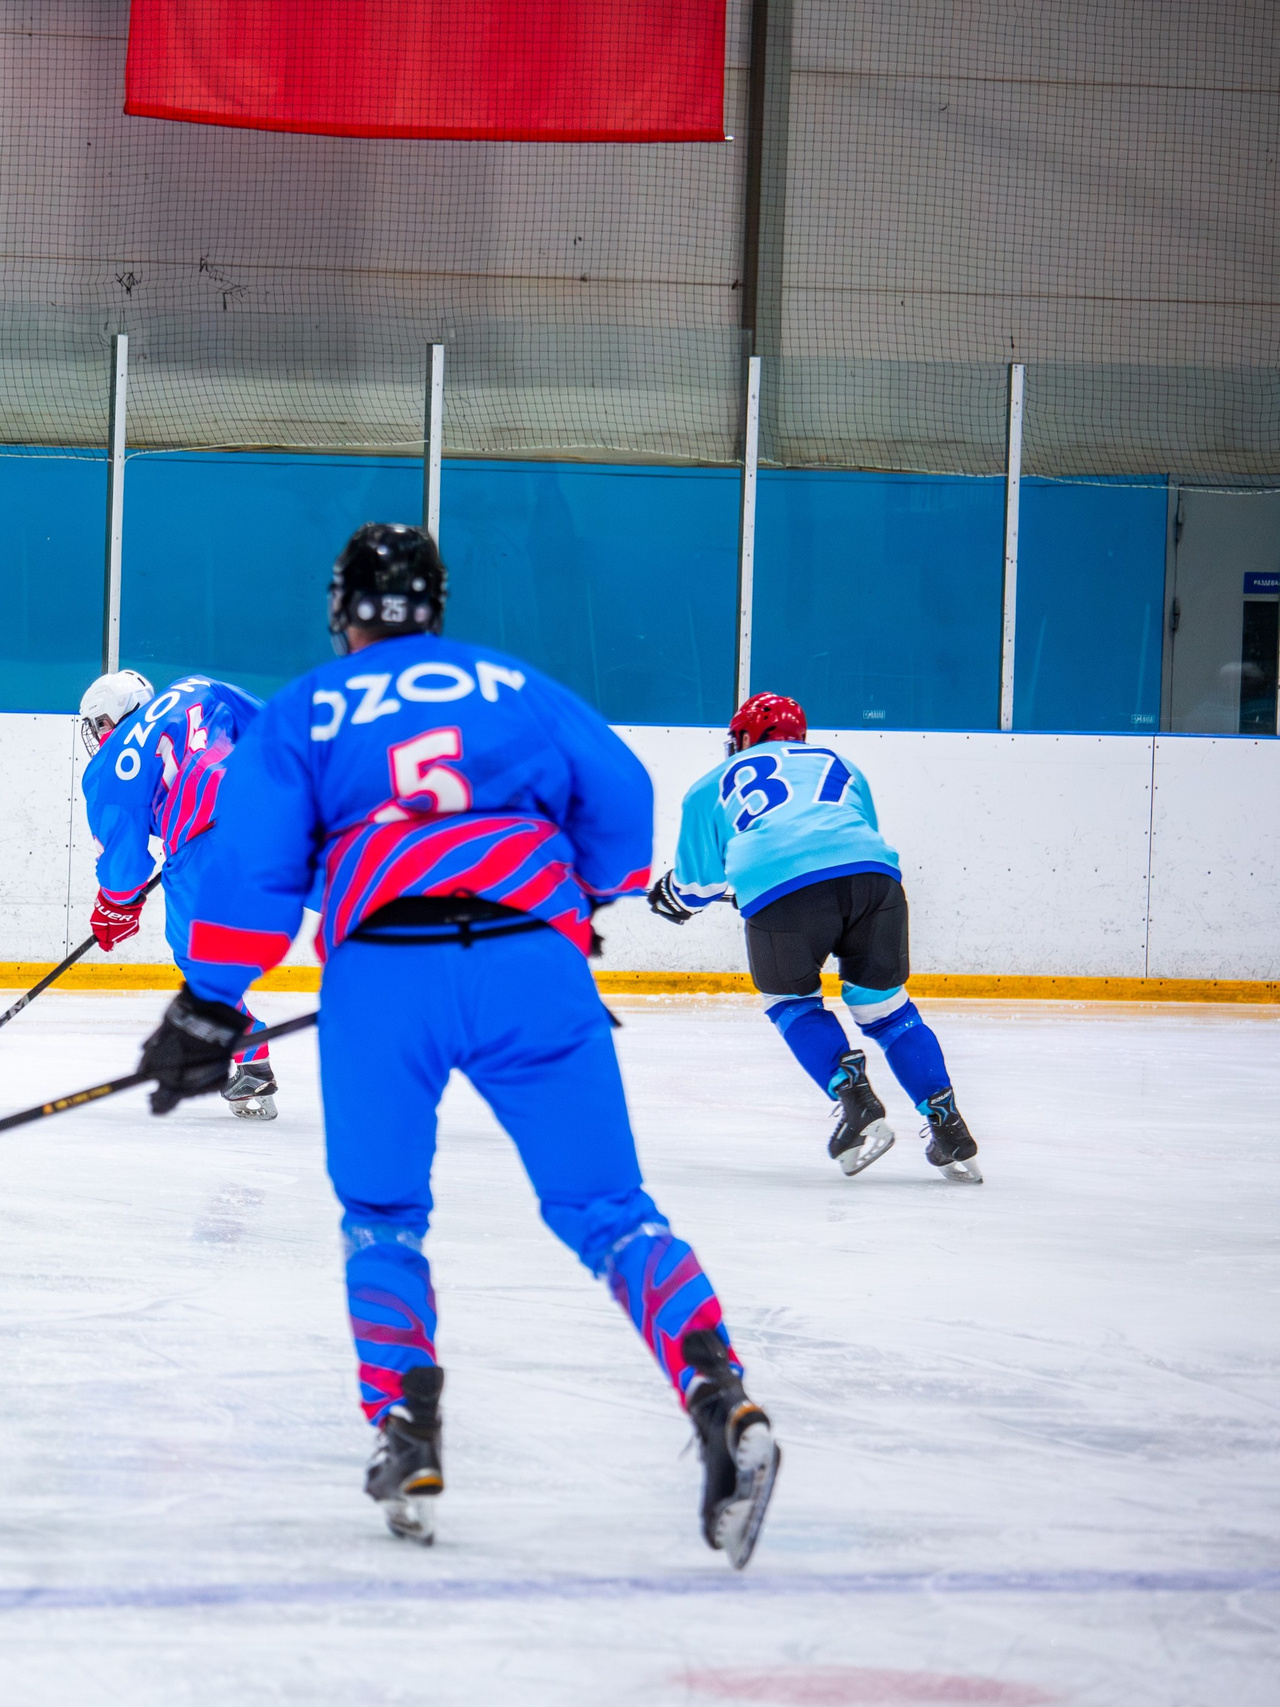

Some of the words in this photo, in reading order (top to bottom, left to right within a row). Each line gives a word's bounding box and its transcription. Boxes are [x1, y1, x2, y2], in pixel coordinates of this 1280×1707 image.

[1253, 579, 1280, 587] РАЗДЕВА
[114, 678, 211, 781] OZON
[367, 725, 474, 825] 5
[719, 747, 856, 834] 37
[93, 899, 134, 921] AUER
